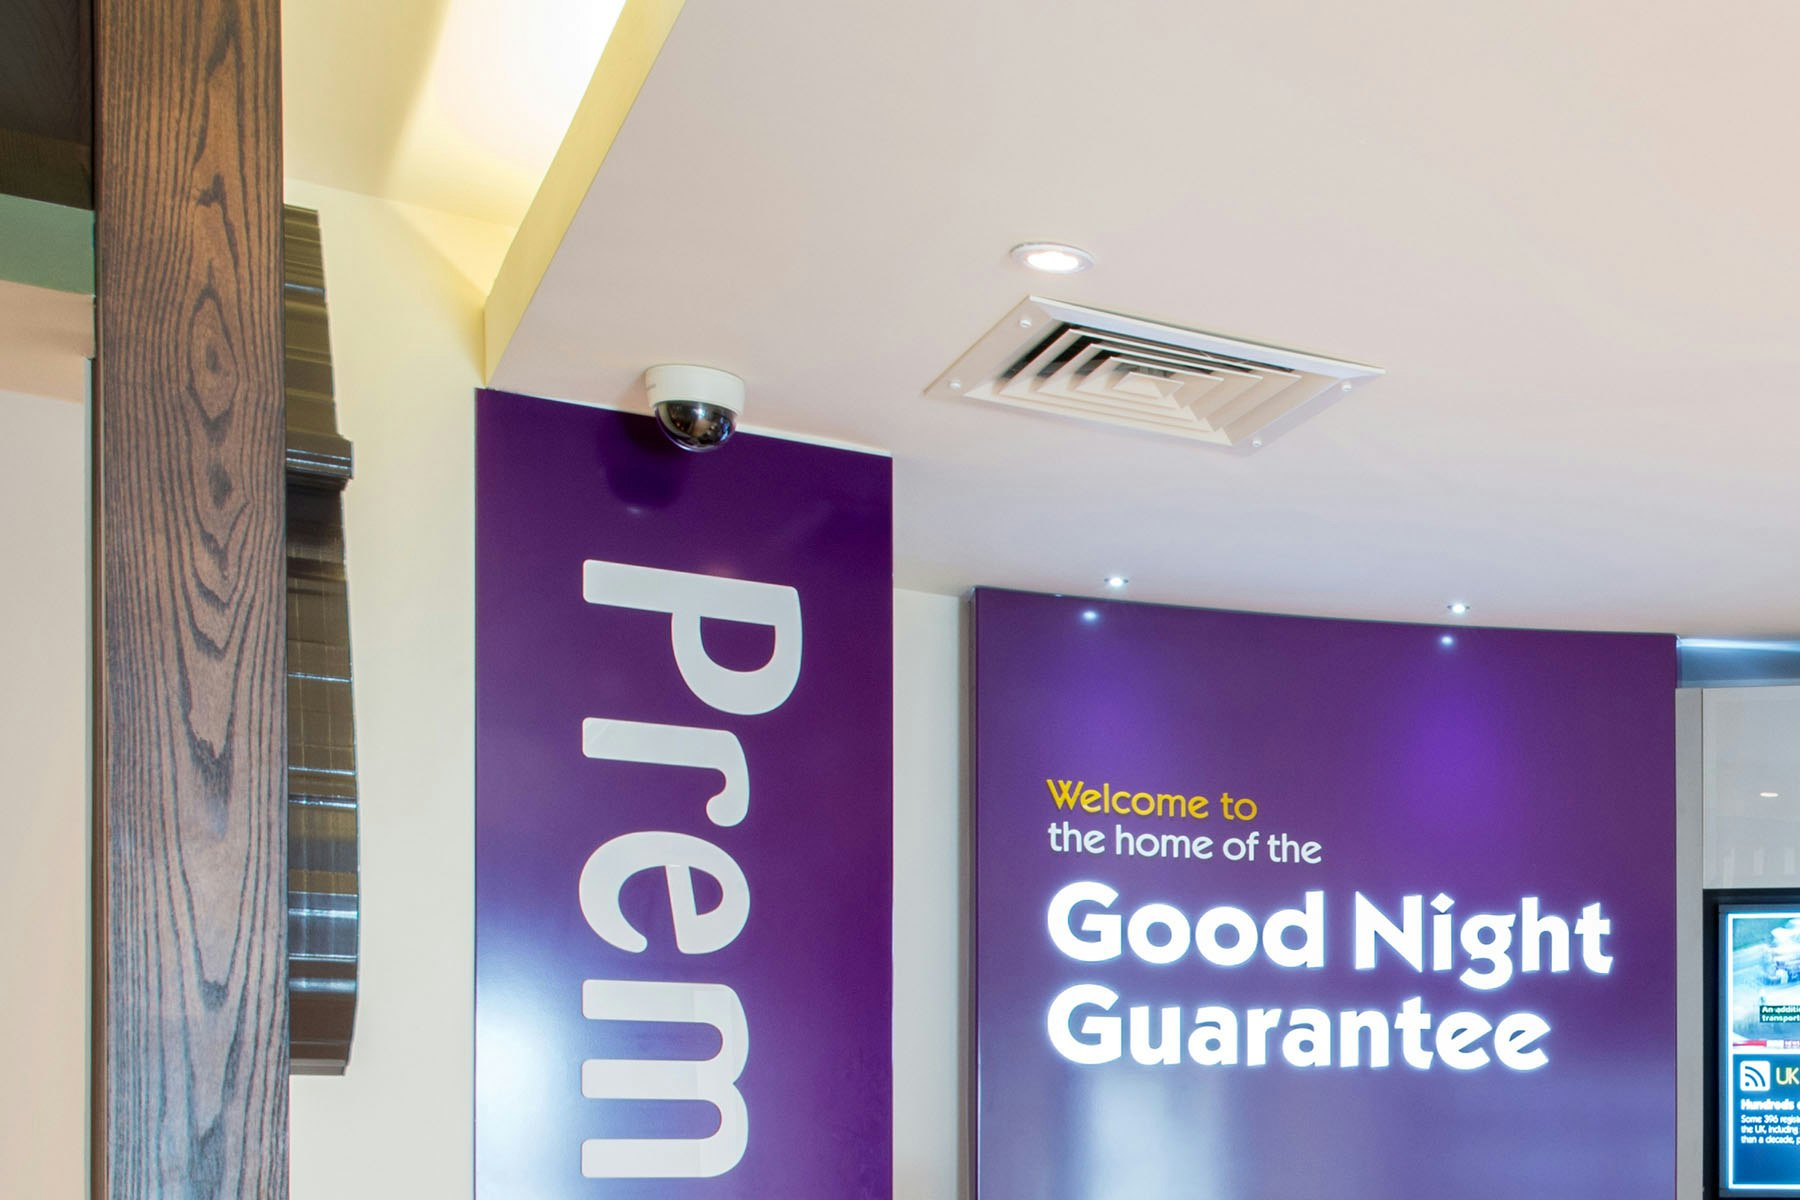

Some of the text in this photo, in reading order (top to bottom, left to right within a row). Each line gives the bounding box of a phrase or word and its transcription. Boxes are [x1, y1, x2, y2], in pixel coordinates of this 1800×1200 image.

[1047, 779, 1258, 821] Welcome to
[1048, 821, 1323, 865] the home of the
[1047, 881, 1614, 991] Good Night
[1047, 983, 1552, 1072] Guarantee
[1775, 1067, 1800, 1085] UK
[1741, 1098, 1795, 1110] Hundreds
[1741, 1114, 1762, 1123] Some
[1741, 1125, 1753, 1134] the
[1768, 1125, 1799, 1135] including
[1741, 1135, 1757, 1144] than
